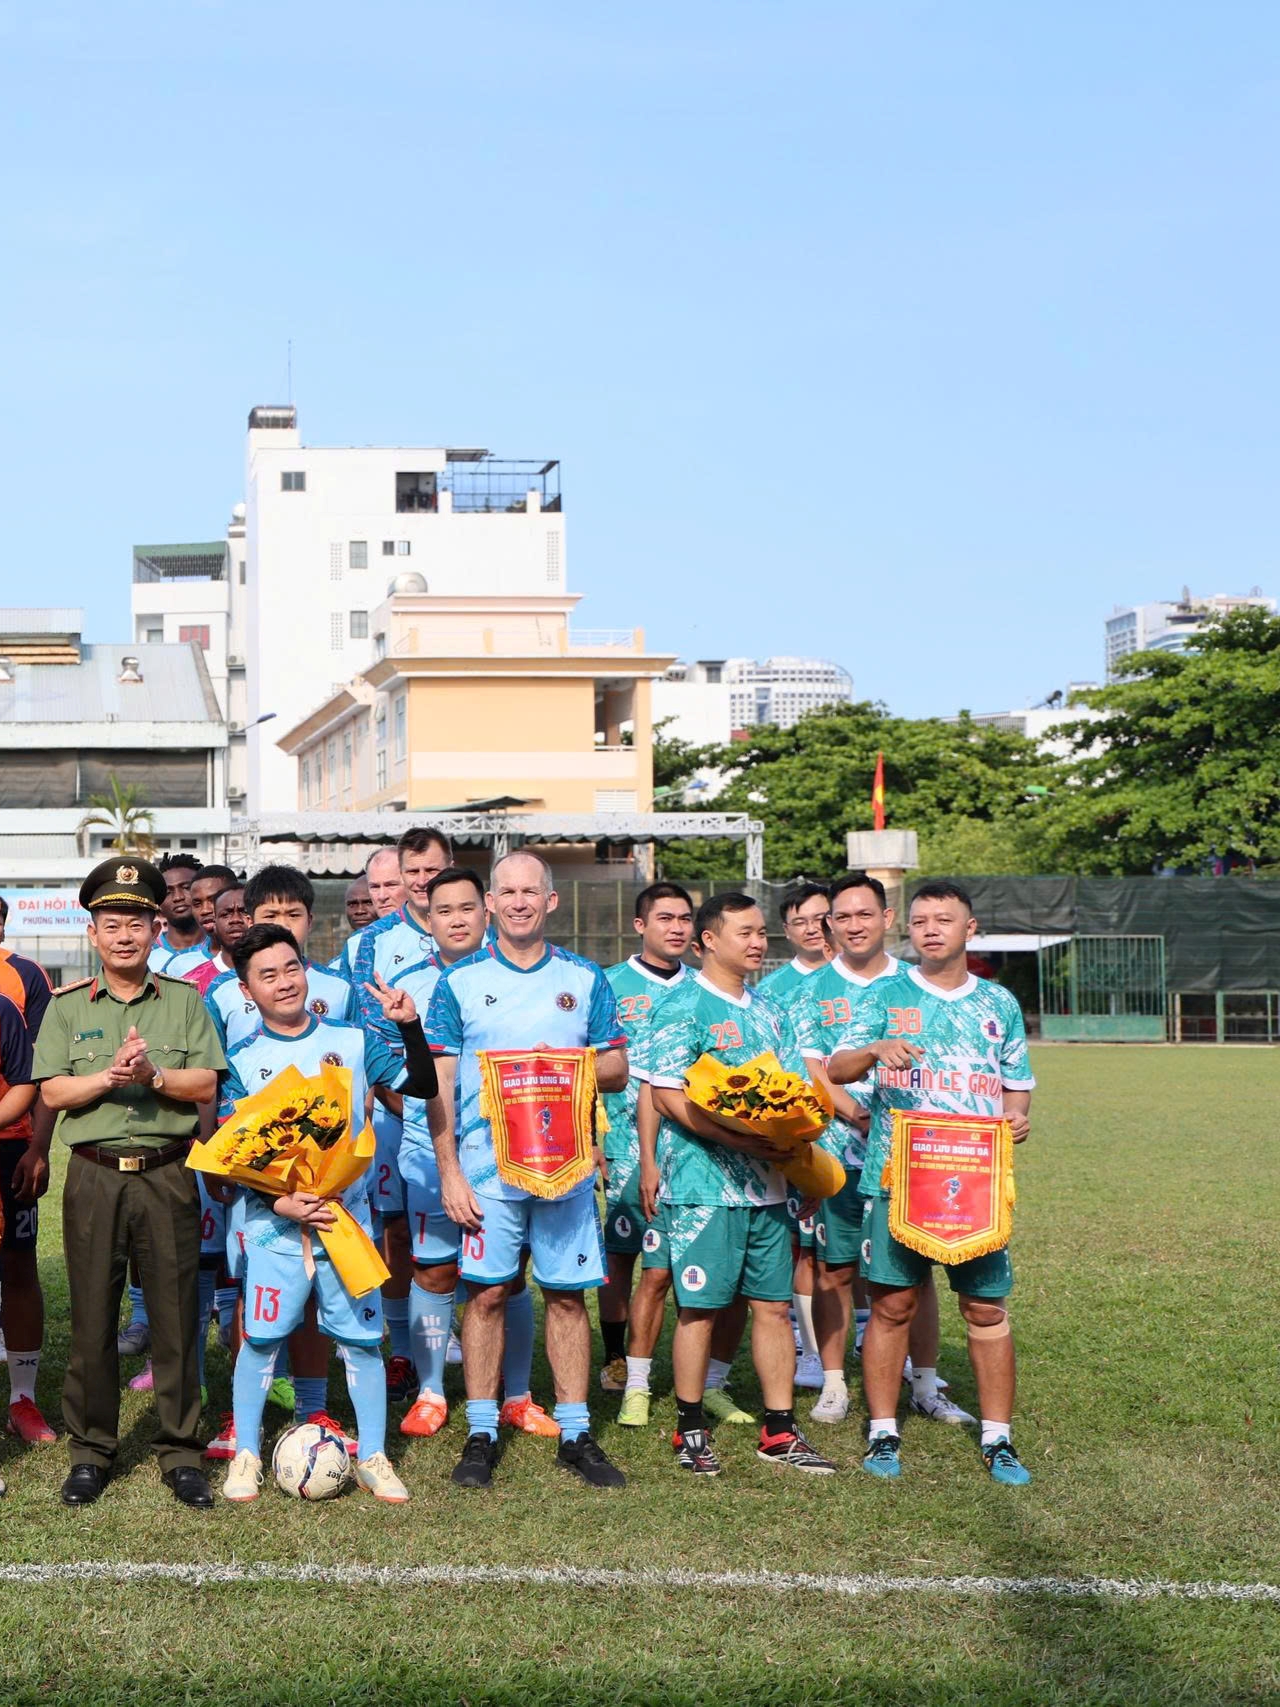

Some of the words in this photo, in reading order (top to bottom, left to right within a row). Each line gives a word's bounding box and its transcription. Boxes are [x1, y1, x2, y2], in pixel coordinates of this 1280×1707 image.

[818, 997, 852, 1027] 33
[887, 1007, 922, 1035] 38
[710, 1019, 743, 1050] 29
[503, 1078, 521, 1088] GIAO
[877, 1067, 934, 1090] THUAN
[938, 1070, 962, 1092] LE
[912, 1142, 932, 1152] GIAO
[378, 1164, 391, 1196] 2
[15, 1206, 37, 1239] 20
[415, 1211, 427, 1245] 7
[462, 1228, 486, 1261] 15
[253, 1284, 281, 1323] 13
